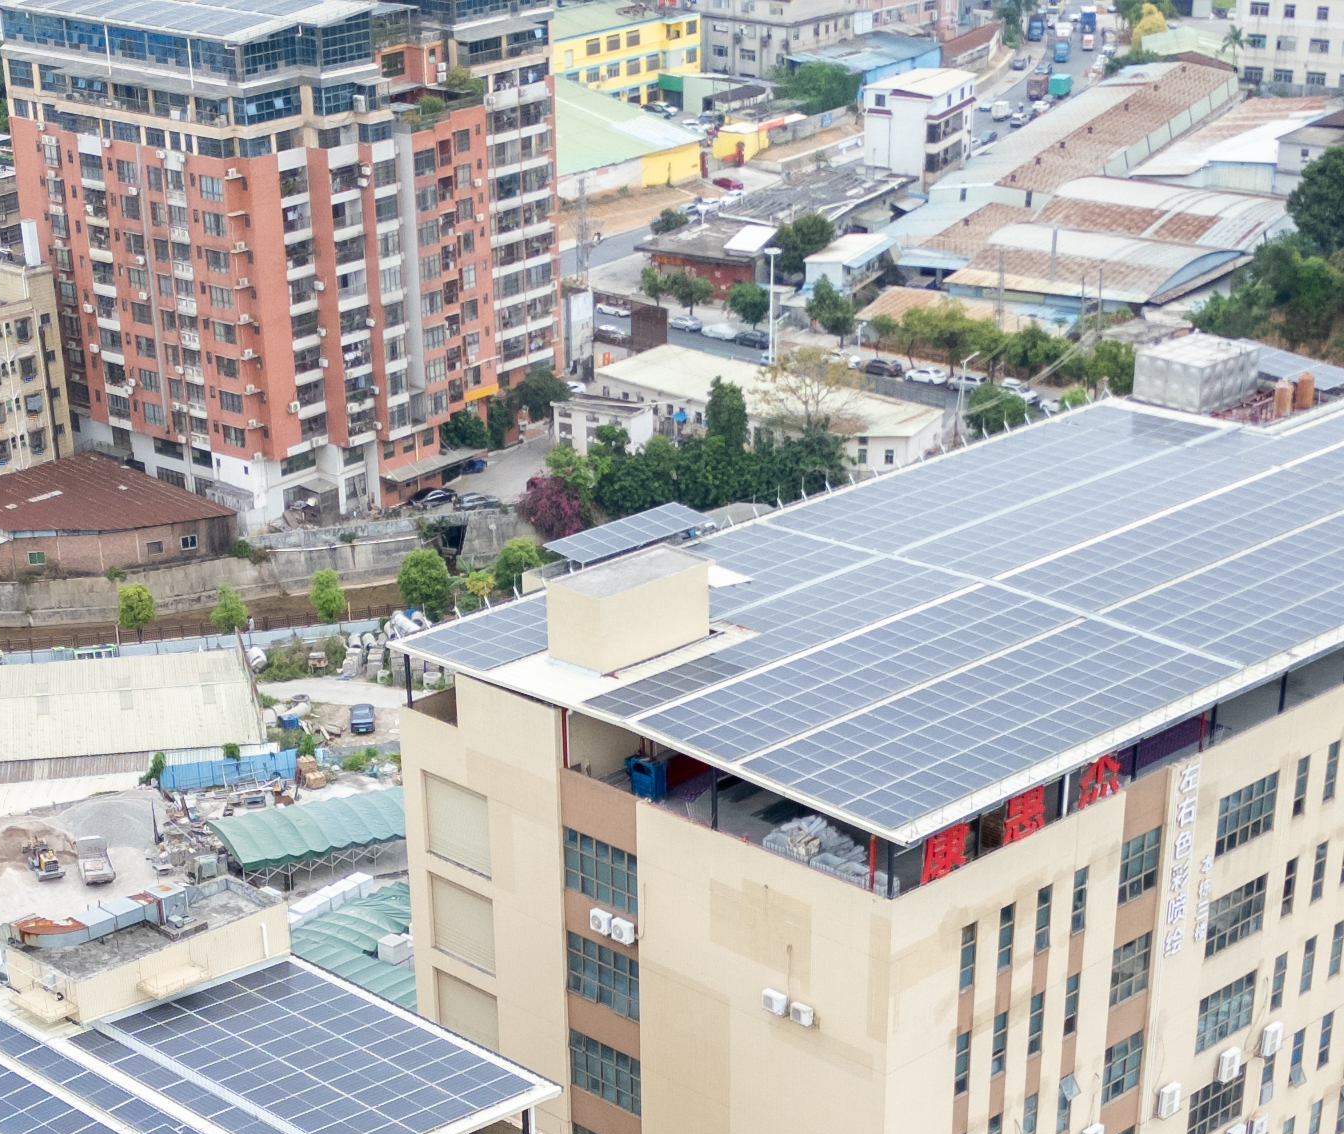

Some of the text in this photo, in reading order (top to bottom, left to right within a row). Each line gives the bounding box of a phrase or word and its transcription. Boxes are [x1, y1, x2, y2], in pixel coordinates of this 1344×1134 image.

[1163, 763, 1201, 958] 左右色彩喷绘
